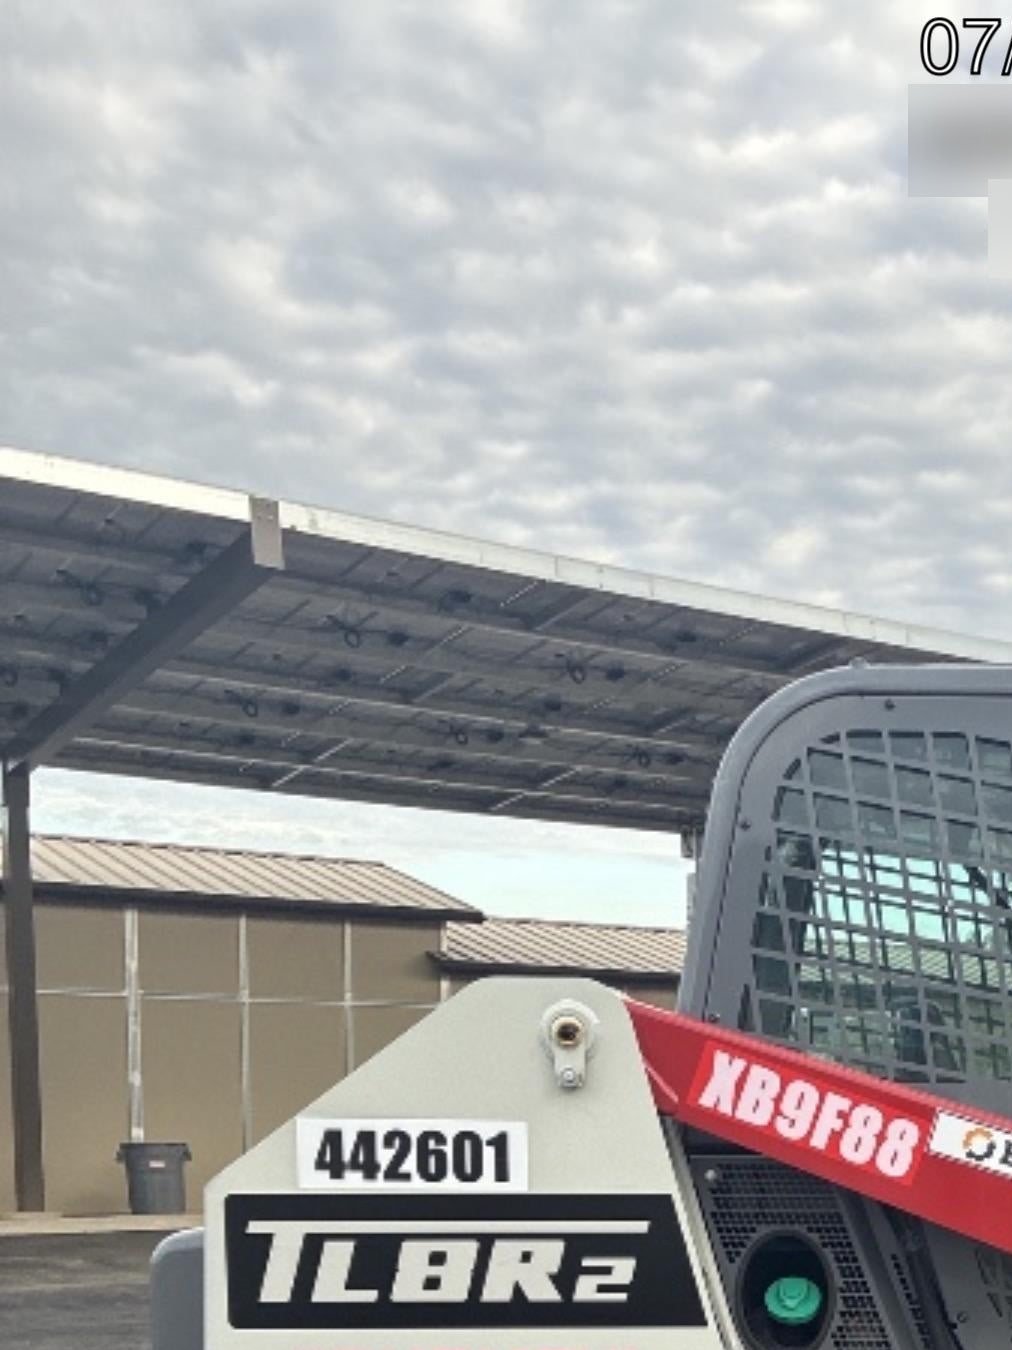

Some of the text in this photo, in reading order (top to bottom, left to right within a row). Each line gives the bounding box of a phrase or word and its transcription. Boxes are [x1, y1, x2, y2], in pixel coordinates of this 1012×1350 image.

[315, 1128, 511, 1183] 442601
[698, 1052, 920, 1179] XB9F88
[245, 1219, 652, 1304] TL8R2
